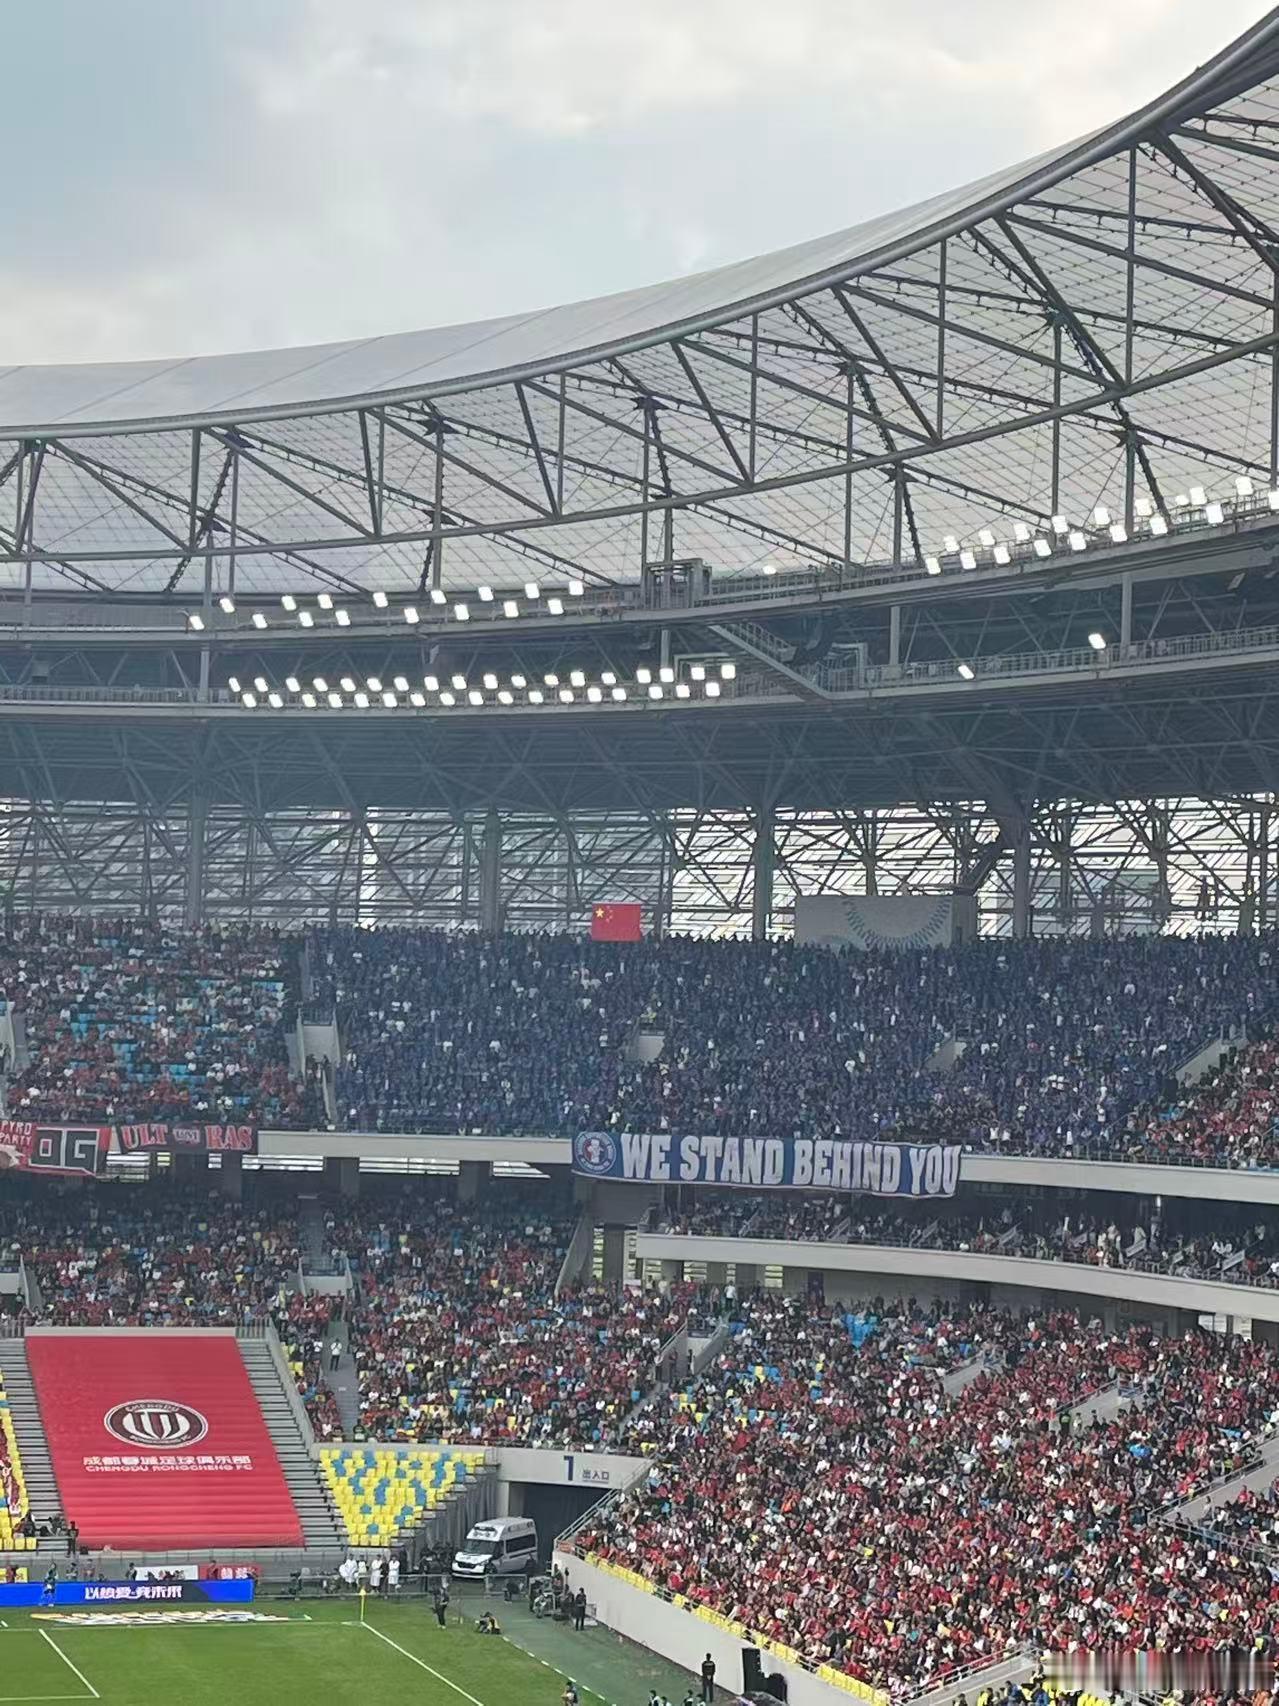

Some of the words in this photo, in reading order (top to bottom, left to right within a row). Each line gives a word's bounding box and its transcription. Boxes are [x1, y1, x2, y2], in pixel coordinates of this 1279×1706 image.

[1, 1120, 32, 1135] PYRO
[121, 1124, 168, 1150] ULT
[204, 1125, 253, 1151] RAS
[621, 1133, 671, 1180] WE
[679, 1135, 784, 1185] STAND
[792, 1140, 901, 1193] BEHIND
[909, 1144, 962, 1195] YOU
[236, 1463, 253, 1471] FC
[563, 1455, 574, 1481] 1
[582, 1469, 610, 1481] 出入口
